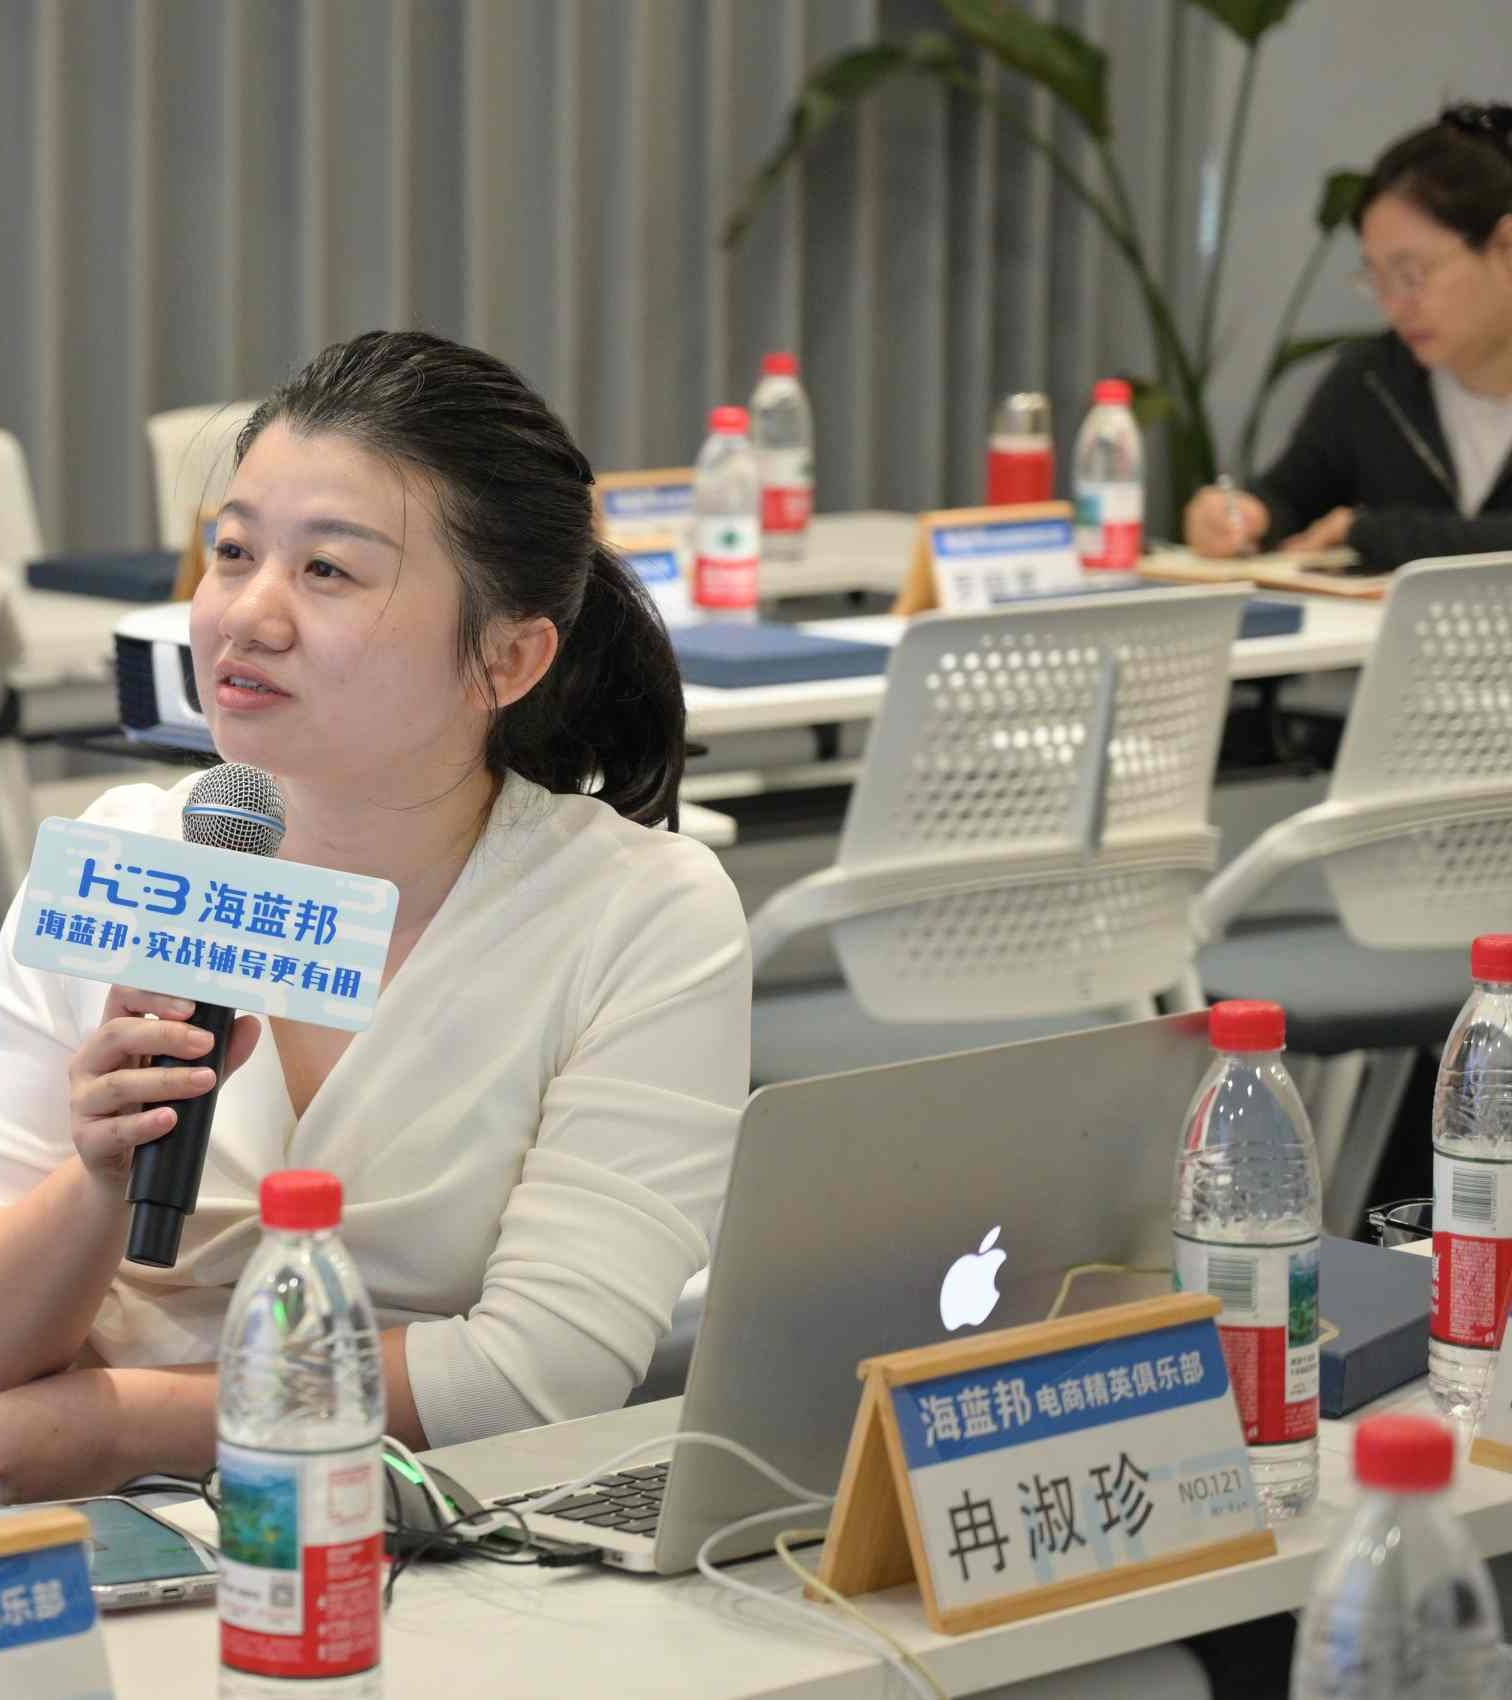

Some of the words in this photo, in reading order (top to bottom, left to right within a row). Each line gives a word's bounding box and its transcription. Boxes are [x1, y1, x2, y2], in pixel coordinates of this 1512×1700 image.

[35, 908, 362, 999] 海蓝邦·实战辅导更有用
[198, 880, 339, 945] 海蓝邦
[919, 1378, 1033, 1448] 海蓝邦
[1035, 1350, 1205, 1418] 电商精英俱乐部
[947, 1451, 1155, 1582] 冉淑珍
[1178, 1468, 1242, 1503] NO.121
